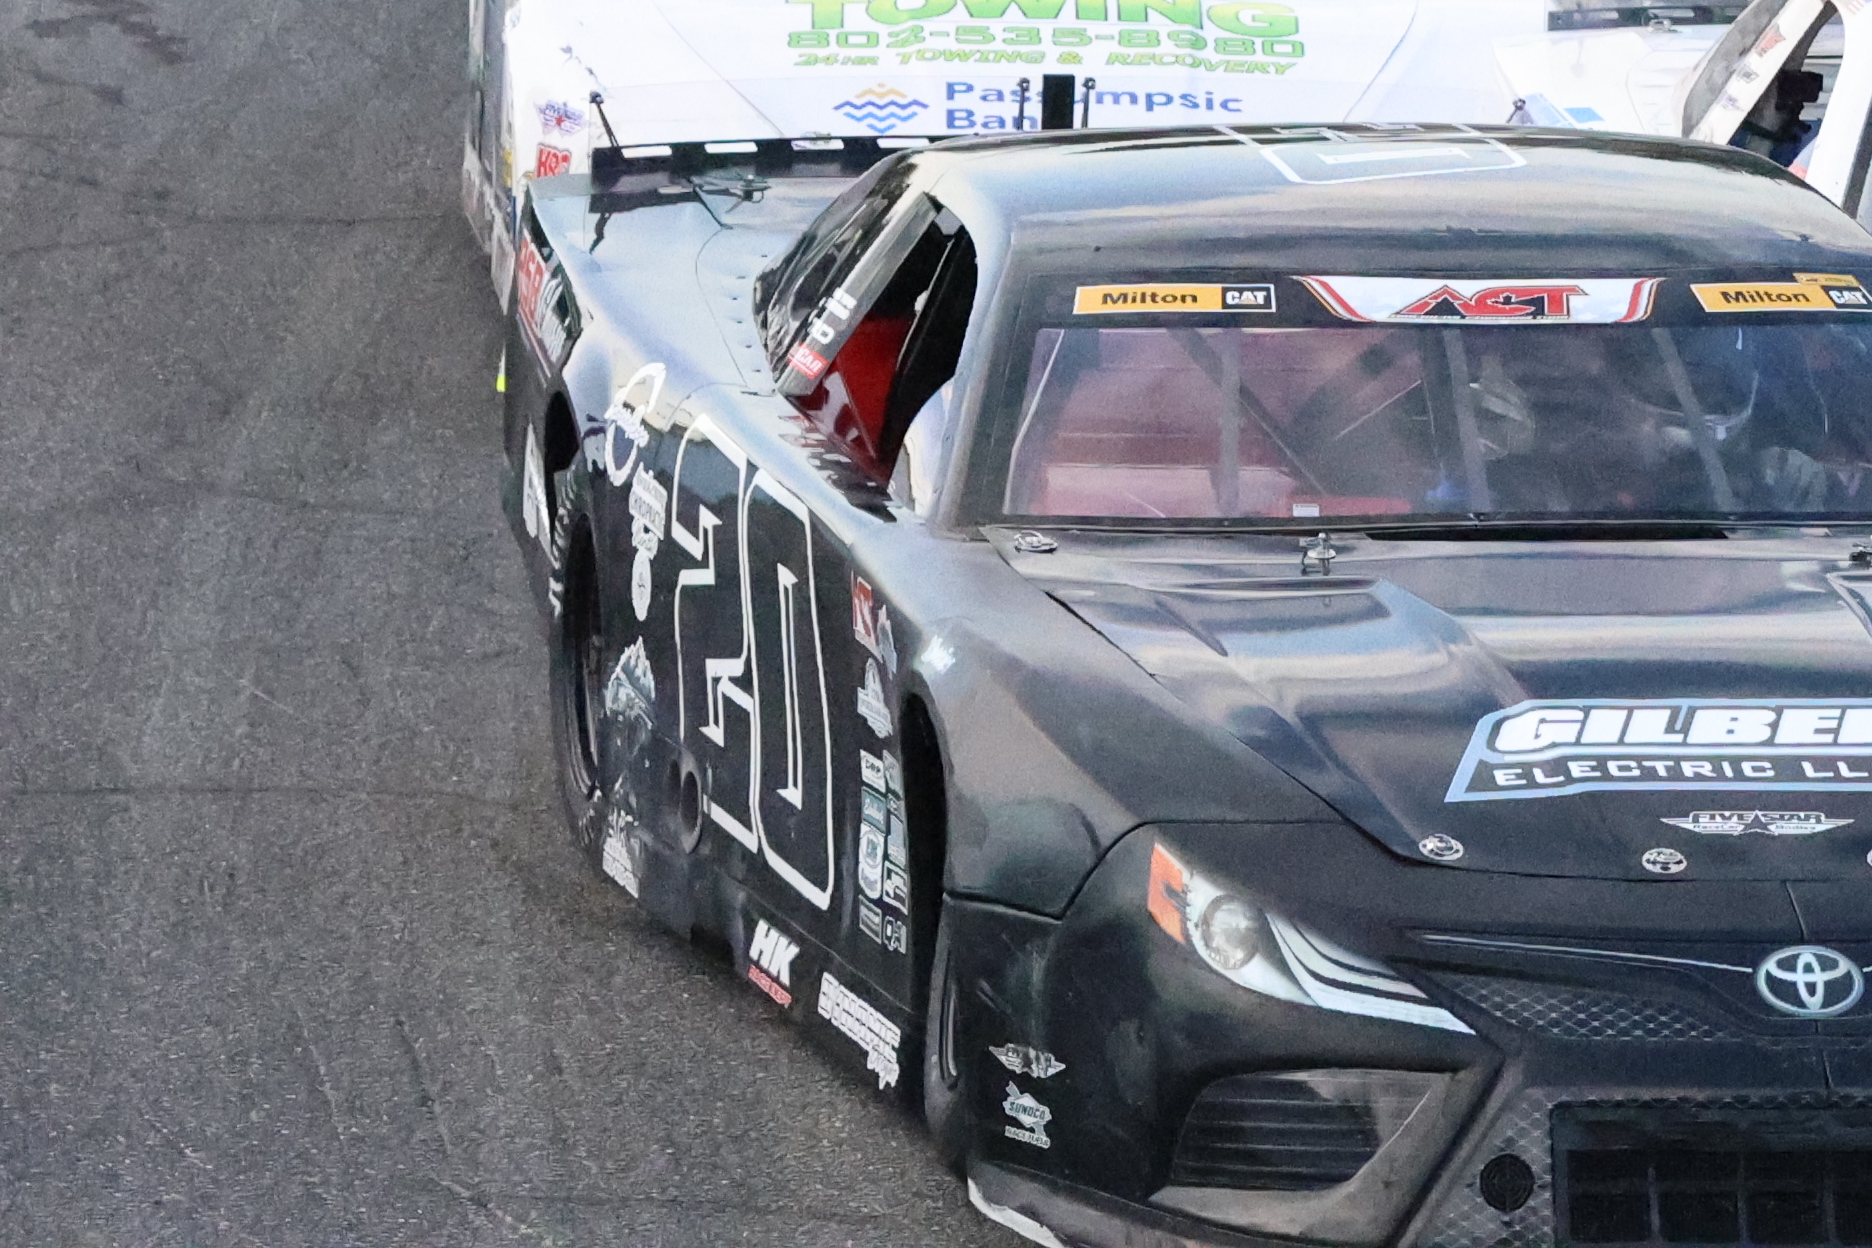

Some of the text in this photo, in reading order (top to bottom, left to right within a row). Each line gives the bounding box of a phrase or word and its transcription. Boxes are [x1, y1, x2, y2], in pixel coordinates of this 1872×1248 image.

[786, 25, 1305, 59] 802-535-8980
[898, 49, 1046, 66] TOWING
[1055, 50, 1085, 66] &
[1105, 52, 1300, 76] RECOVERY
[945, 81, 1244, 114] Pasmpsic
[945, 107, 1040, 131] Ban
[1100, 289, 1268, 306] Milton CAT
[1389, 284, 1590, 320] ACT
[1722, 288, 1867, 305] Milton CAT
[1493, 758, 1776, 787] ELECTRIC
[1697, 812, 1824, 824] FIVE STAR
[748, 918, 800, 988] HK
[1008, 1101, 1047, 1121] SUNOCO
